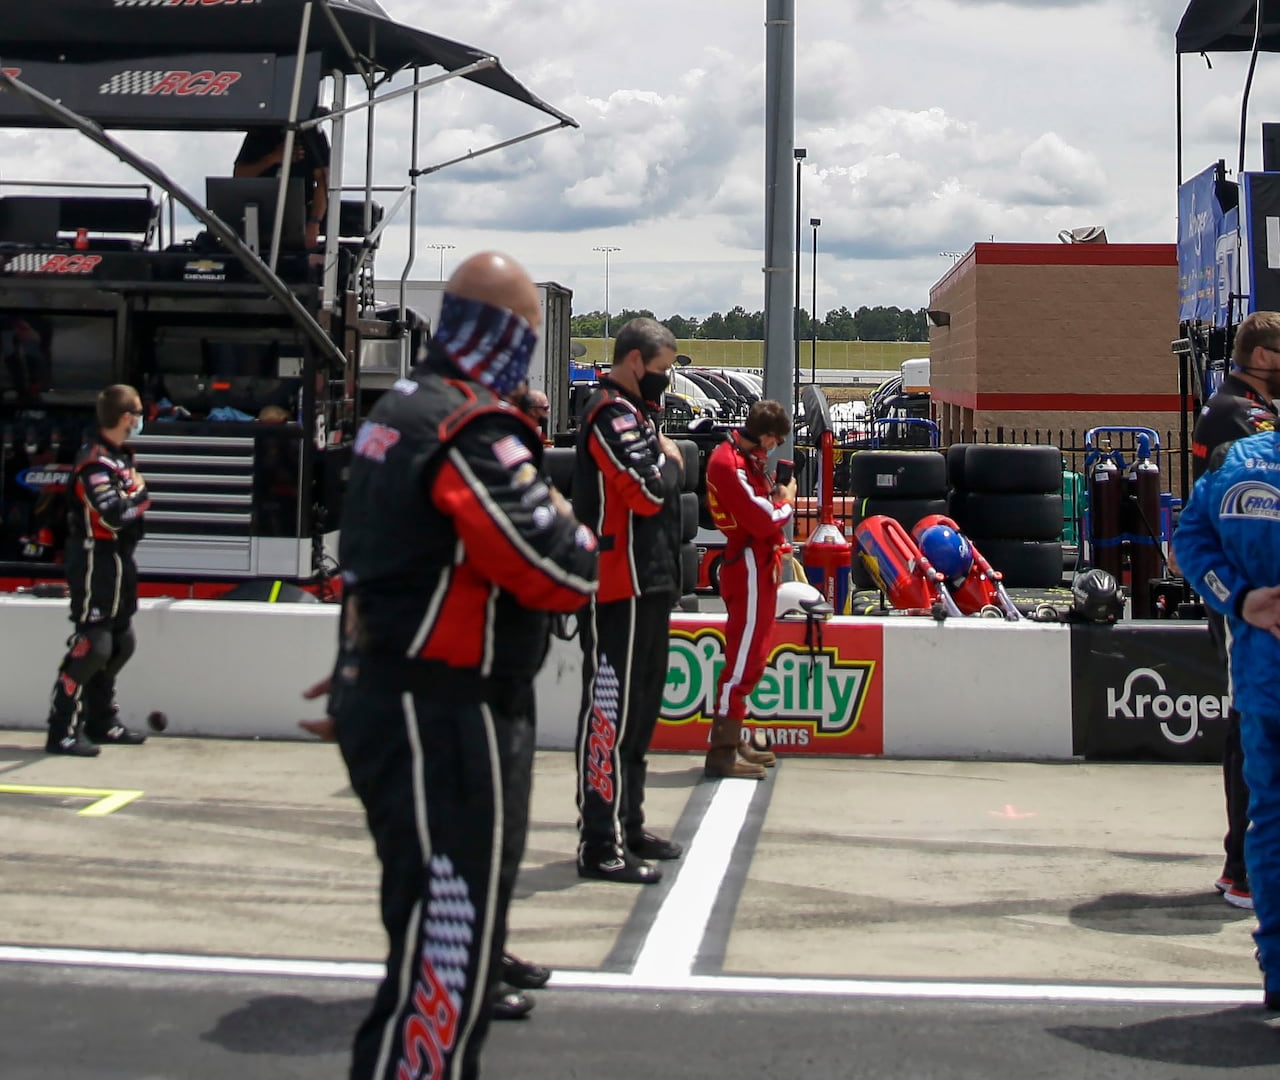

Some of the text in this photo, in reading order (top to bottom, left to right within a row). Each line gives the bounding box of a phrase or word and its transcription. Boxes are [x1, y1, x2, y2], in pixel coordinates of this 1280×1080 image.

[149, 71, 242, 96] RCR
[40, 254, 103, 273] RCR
[1107, 667, 1232, 743] Kroger
[587, 704, 617, 802] RCR
[396, 957, 461, 1080] RC
